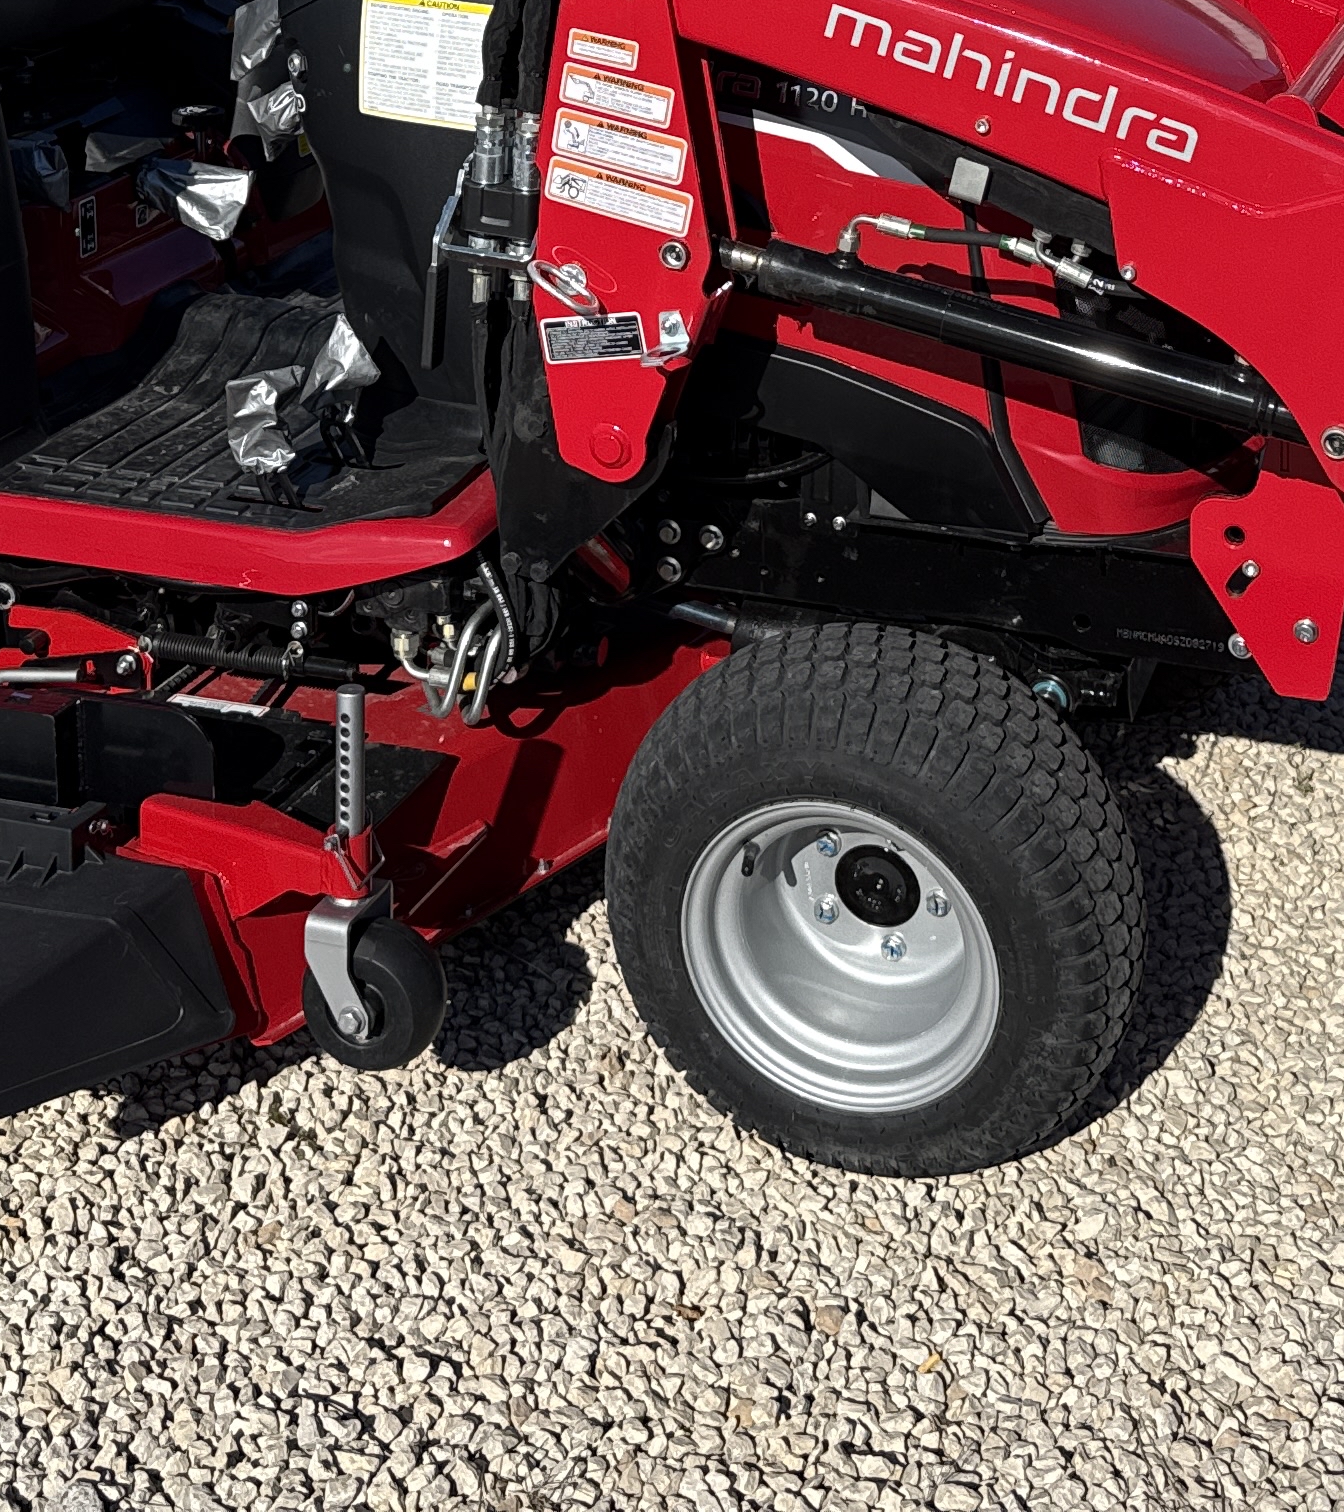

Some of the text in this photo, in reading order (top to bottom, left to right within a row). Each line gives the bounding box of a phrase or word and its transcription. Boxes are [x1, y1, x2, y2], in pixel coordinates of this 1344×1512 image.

[426, 0, 460, 11] CAUTION
[590, 35, 626, 50] WARNING
[603, 74, 645, 92] WARNING
[823, 3, 1199, 163] mahindra
[776, 81, 838, 113] 1120
[606, 122, 648, 140] WARNING
[605, 173, 647, 192] WARNING
